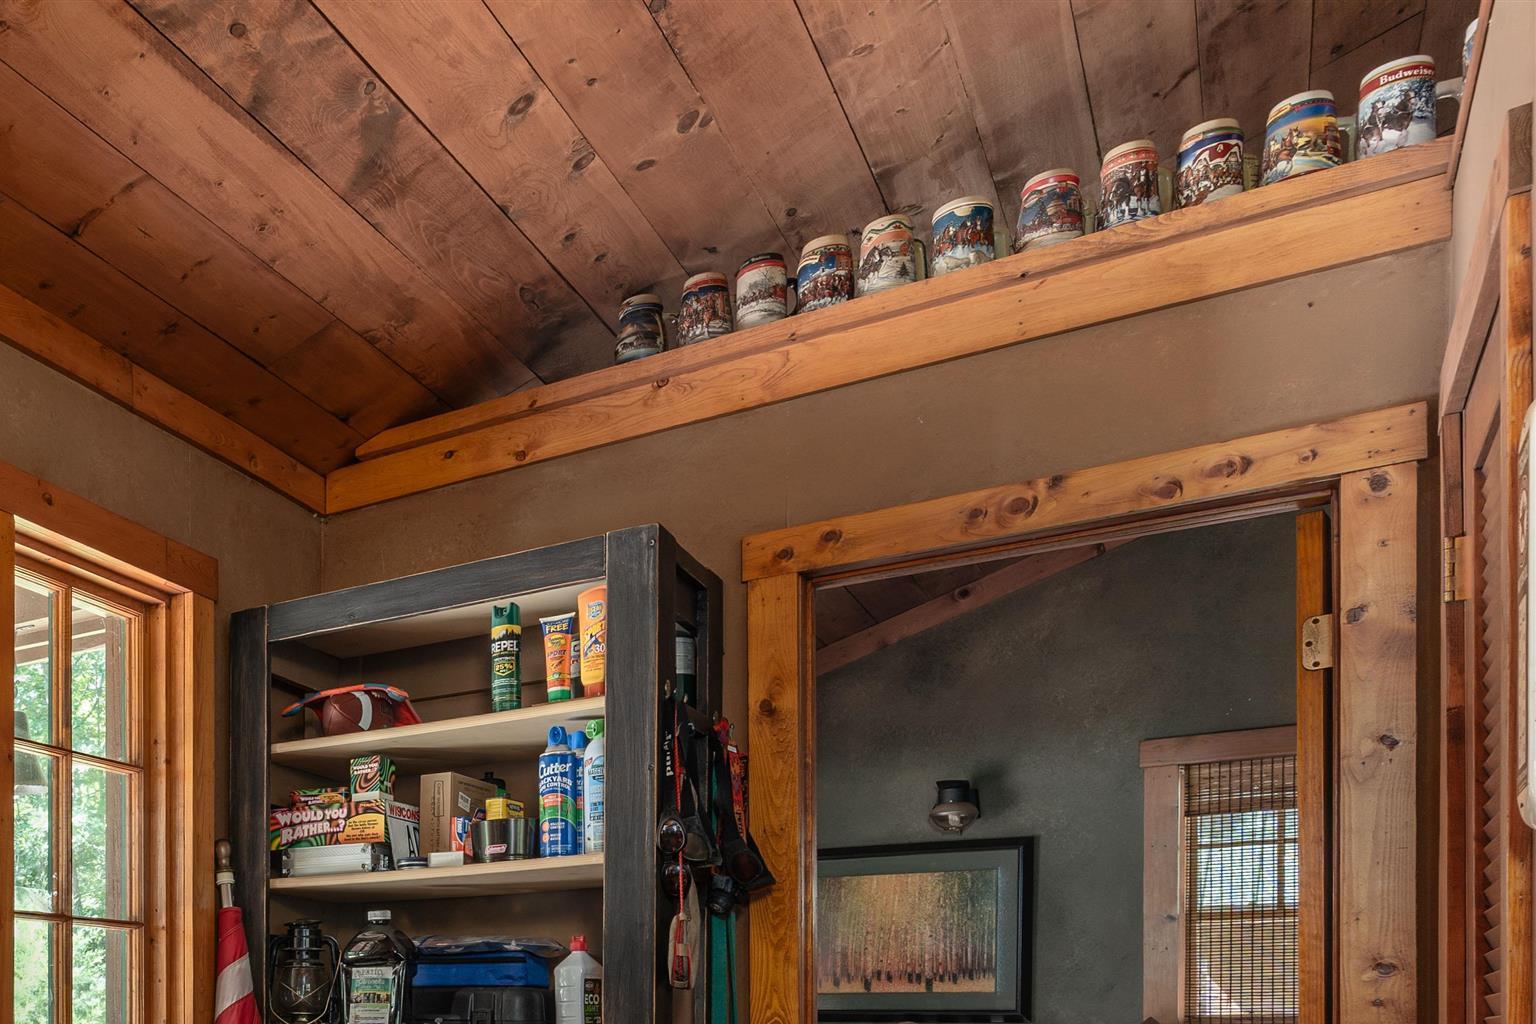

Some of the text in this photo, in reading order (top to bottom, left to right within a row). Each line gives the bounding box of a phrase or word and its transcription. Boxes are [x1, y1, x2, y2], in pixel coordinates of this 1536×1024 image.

[545, 622, 569, 634] FREE
[491, 640, 519, 654] REPEL
[594, 643, 606, 653] 30
[539, 762, 572, 779] Cutter
[276, 807, 348, 826] WOULD YOU
[585, 993, 600, 1005] ECO
